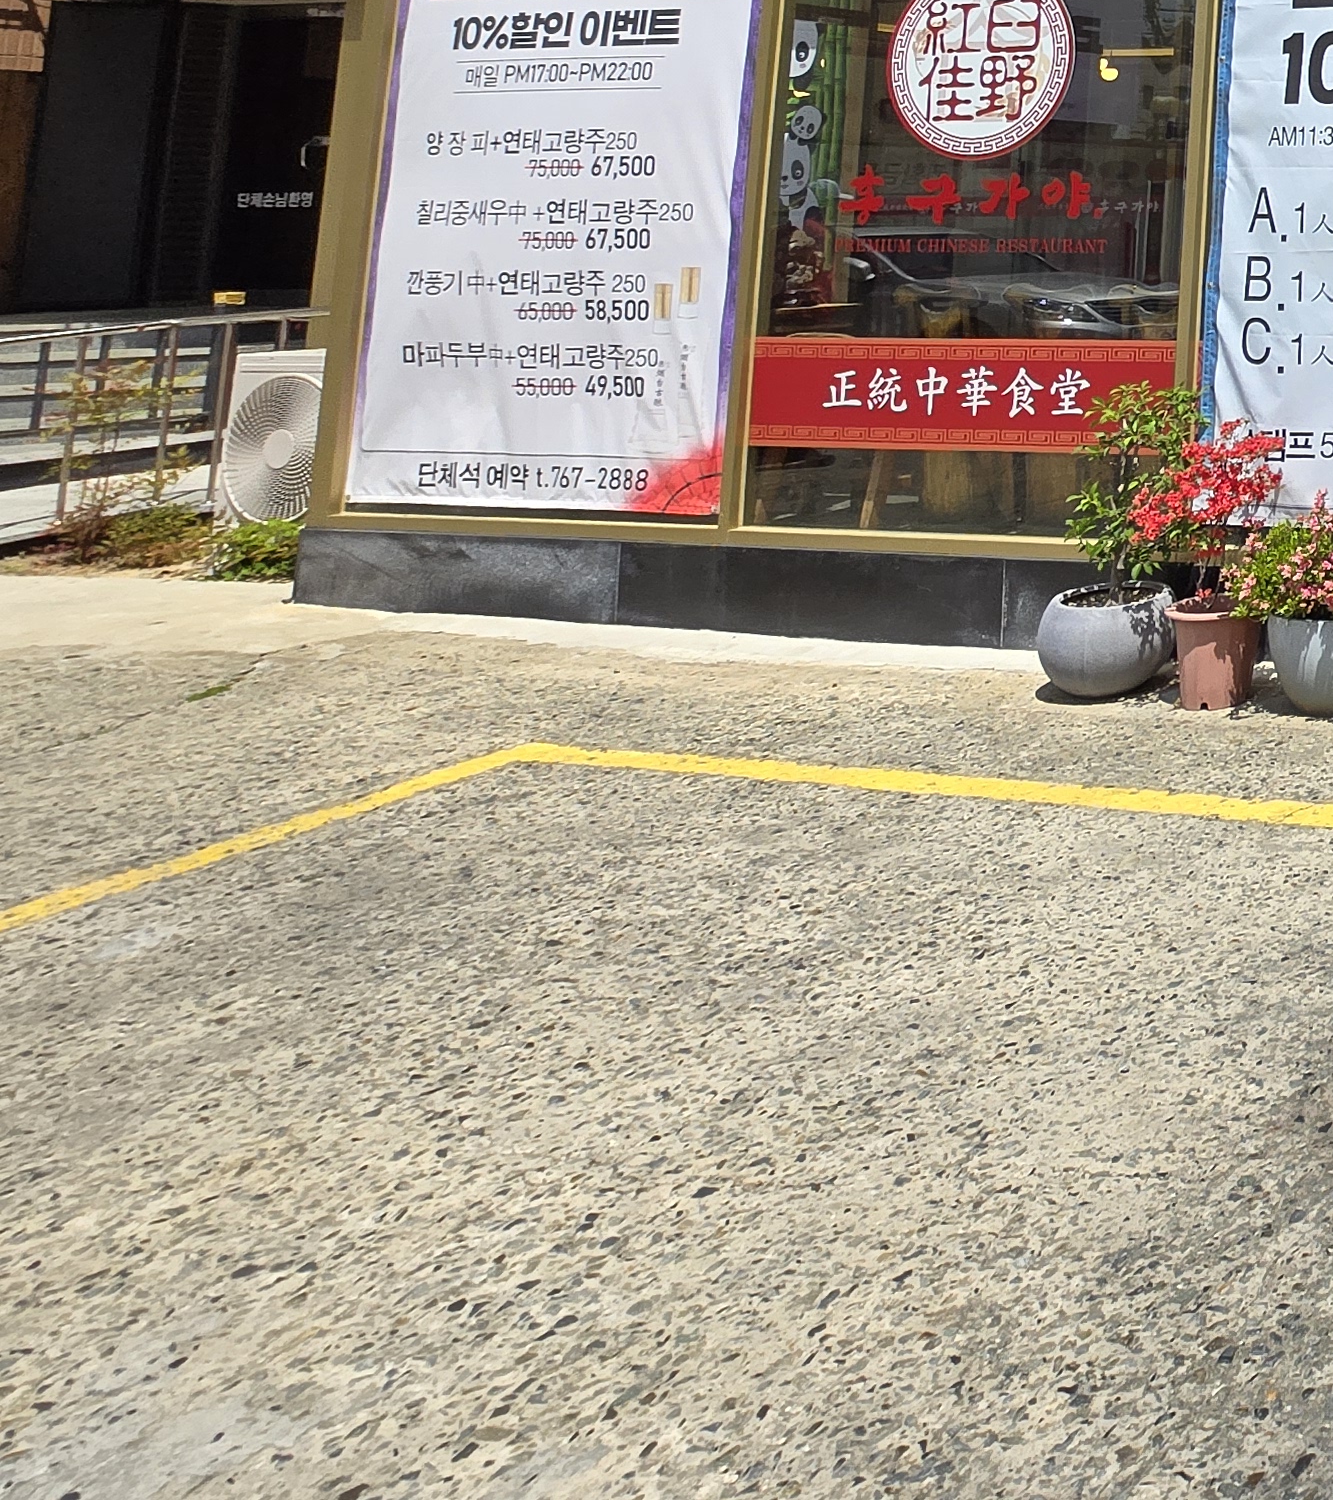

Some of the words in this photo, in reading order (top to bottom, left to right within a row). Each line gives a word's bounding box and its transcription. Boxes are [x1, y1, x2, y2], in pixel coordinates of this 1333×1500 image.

[452, 10, 574, 51] 10%할인
[579, 8, 682, 48] 이벤트
[465, 63, 499, 88] 매일
[503, 61, 653, 84] PM17:00~PM22:00
[528, 159, 581, 178] 75,000
[591, 155, 656, 179] 67,500
[522, 230, 576, 250] 75,000
[585, 228, 651, 253] 67,500
[835, 238, 911, 253] PREMIUM
[917, 238, 990, 254] CHINESE
[996, 239, 1107, 255] RESTAURANT
[406, 269, 463, 296] 깐풍기
[611, 274, 646, 294] 250
[517, 301, 574, 321] 65,000
[584, 299, 650, 324] 58,500
[515, 377, 574, 398] 55,000
[584, 375, 645, 400] 49,500
[821, 366, 1091, 418] 正統中華食堂
[417, 462, 481, 489] 단체석
[486, 465, 530, 491] 예약
[535, 466, 650, 492] t.767-2888
